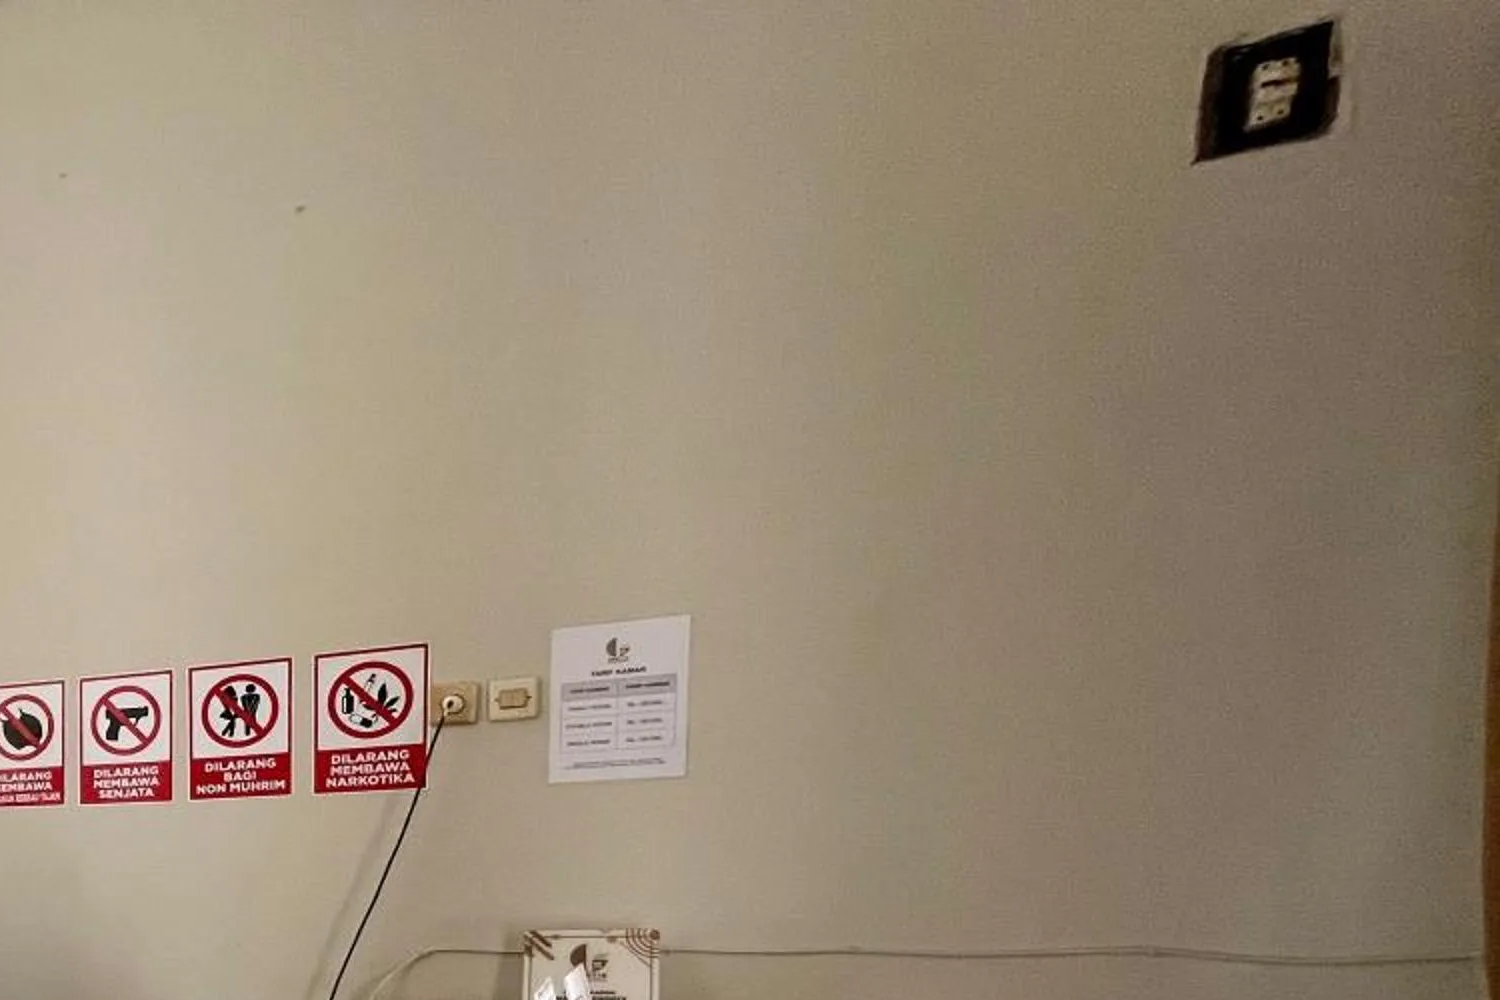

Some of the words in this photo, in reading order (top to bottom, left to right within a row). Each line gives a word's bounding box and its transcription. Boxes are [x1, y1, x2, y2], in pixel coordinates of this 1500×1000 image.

[331, 749, 410, 765] DILARANG
[93, 765, 159, 779] DILARANG
[204, 757, 277, 773] DILARANG
[330, 761, 411, 777] MEMBAWA
[93, 776, 160, 789] MEMBAWA
[223, 771, 257, 783] BAGI
[325, 773, 415, 788] NARKOTIKA
[99, 788, 155, 799] SENJATA
[196, 783, 227, 795] NON
[229, 779, 286, 793] MUHRIM
